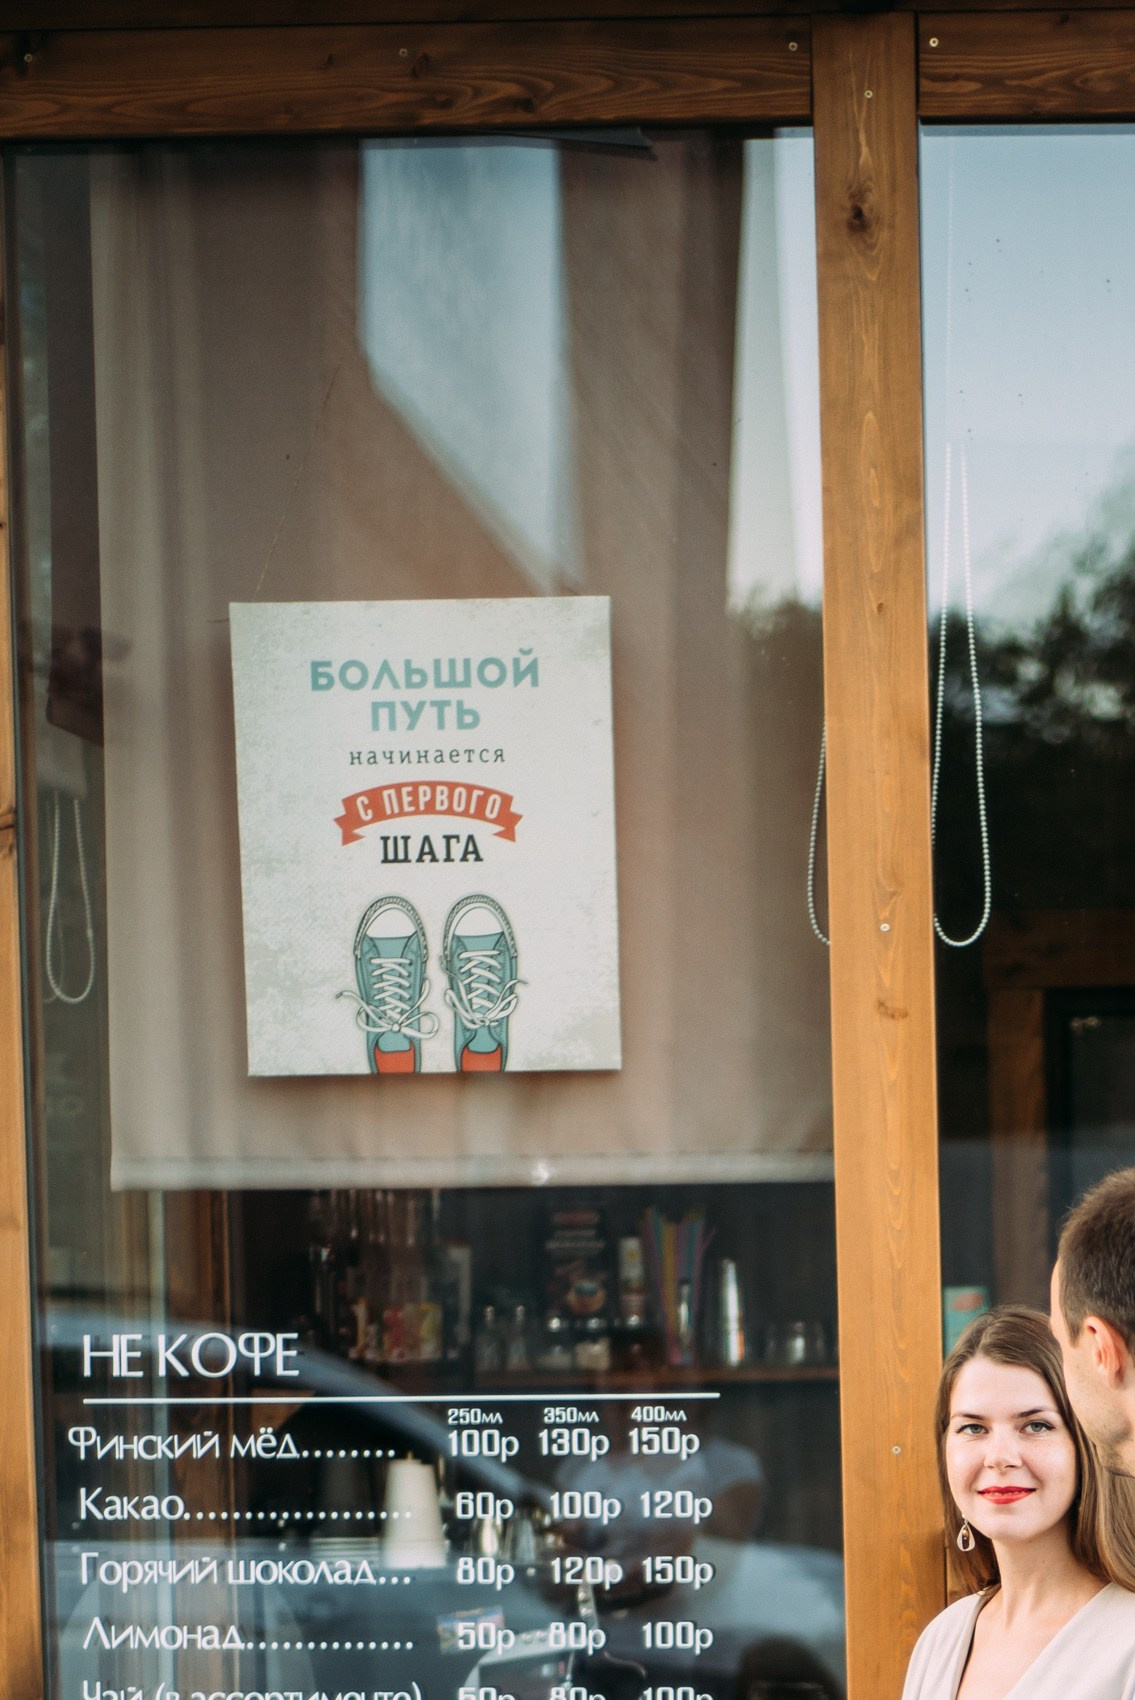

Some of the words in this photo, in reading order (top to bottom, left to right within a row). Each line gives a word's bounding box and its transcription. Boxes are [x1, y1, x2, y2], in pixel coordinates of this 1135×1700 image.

[310, 647, 540, 692] БОЛЬШОЙ
[370, 699, 481, 732] ПУТЬ
[349, 748, 506, 766] начинается
[355, 793, 373, 821] С
[382, 785, 502, 820] ПЕРВОГО
[379, 834, 484, 865] ШАГА
[83, 1333, 144, 1378] НЕ
[157, 1331, 300, 1378] КОФЕ
[447, 1408, 503, 1425] 250мл
[543, 1407, 600, 1423] 350мл
[631, 1405, 687, 1422] 400мл
[67, 1426, 220, 1461] Финский
[447, 1429, 520, 1463] 100р
[538, 1427, 611, 1462] 130р
[628, 1426, 700, 1461] 150р
[455, 1491, 515, 1525] 60р
[549, 1491, 622, 1525] 100р
[640, 1490, 713, 1525] 120р
[81, 1552, 218, 1594] Горячий
[456, 1557, 515, 1591] 80р
[551, 1556, 623, 1591] 120р
[642, 1556, 714, 1590] 150р
[457, 1622, 516, 1655] 50р
[549, 1622, 607, 1656] 80р
[642, 1621, 714, 1656] 100р
